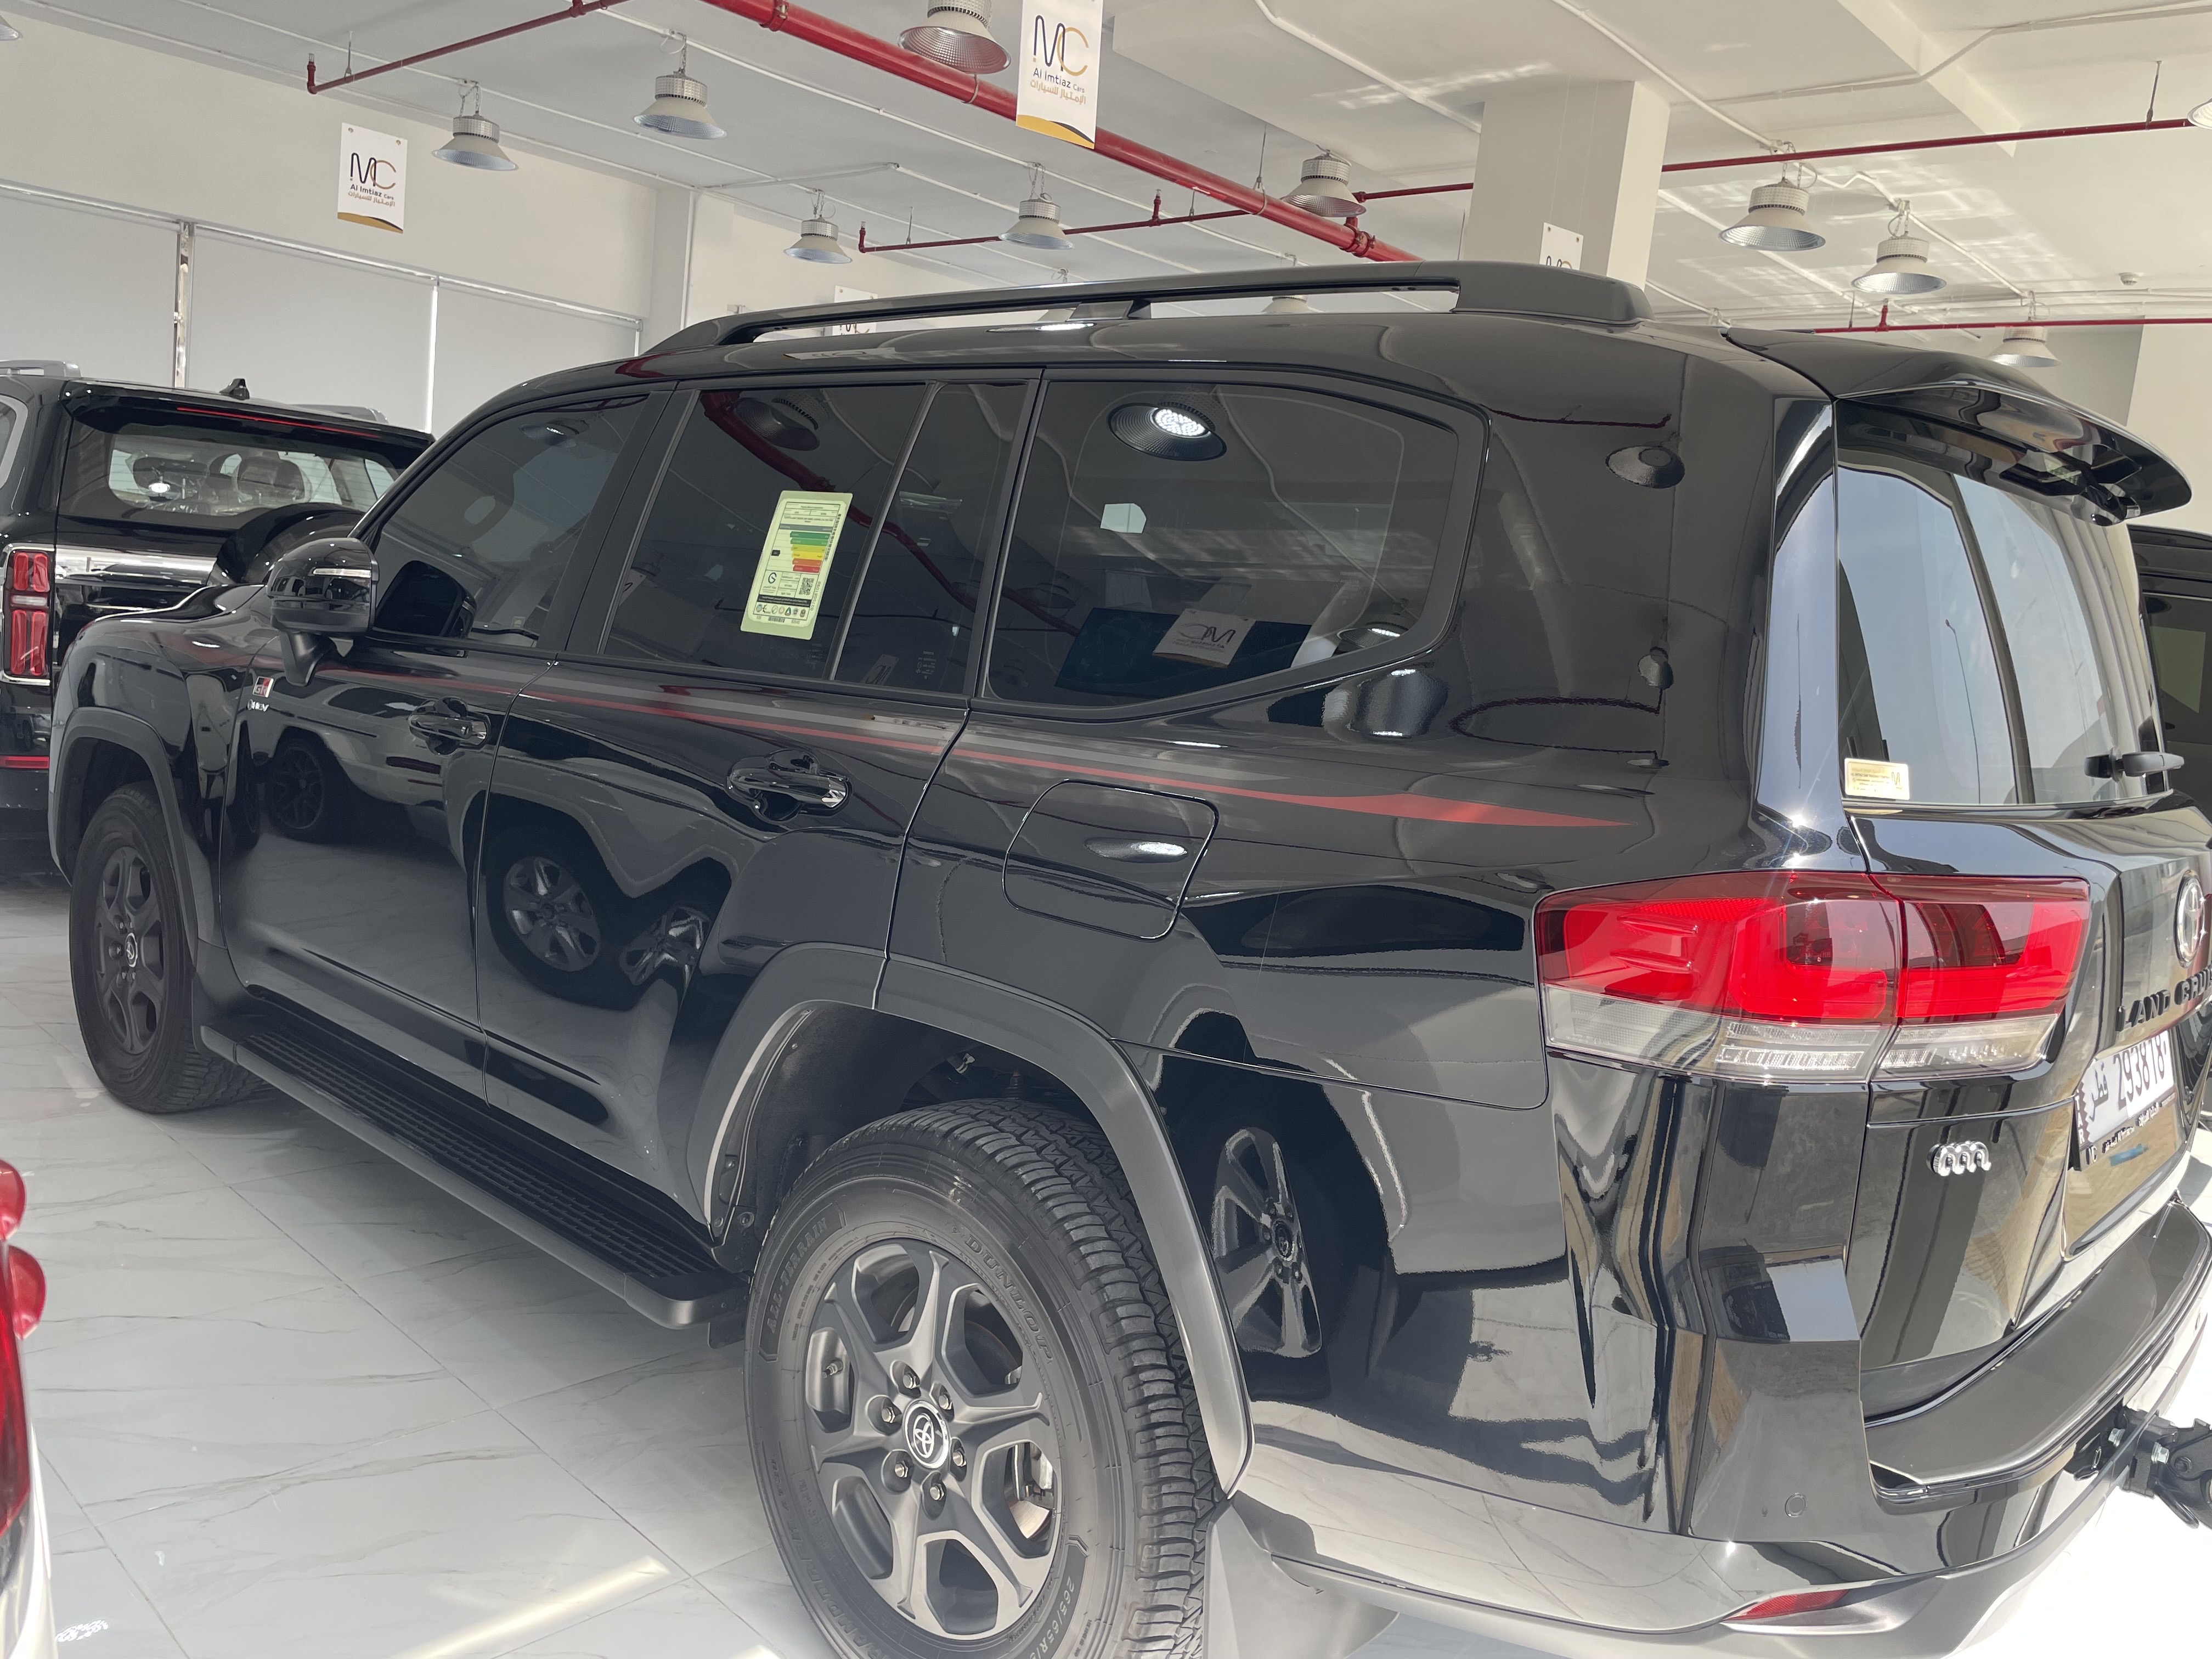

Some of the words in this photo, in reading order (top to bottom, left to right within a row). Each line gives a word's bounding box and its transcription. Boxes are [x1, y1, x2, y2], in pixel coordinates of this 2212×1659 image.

[1033, 15, 1090, 76] MC
[1030, 79, 1059, 95] للسيارات
[1033, 67, 1042, 79] Al
[1045, 70, 1071, 88] Imtiaz
[1073, 84, 1085, 93] Cars
[350, 153, 397, 190] MC
[360, 186, 382, 198] Imtiaz
[2115, 990, 2171, 1032] LAND
[767, 1217, 828, 1334] ALL-TERRAIN
[964, 1235, 1053, 1364] DUNLOP
[788, 1526, 889, 1659] RANDTREK
